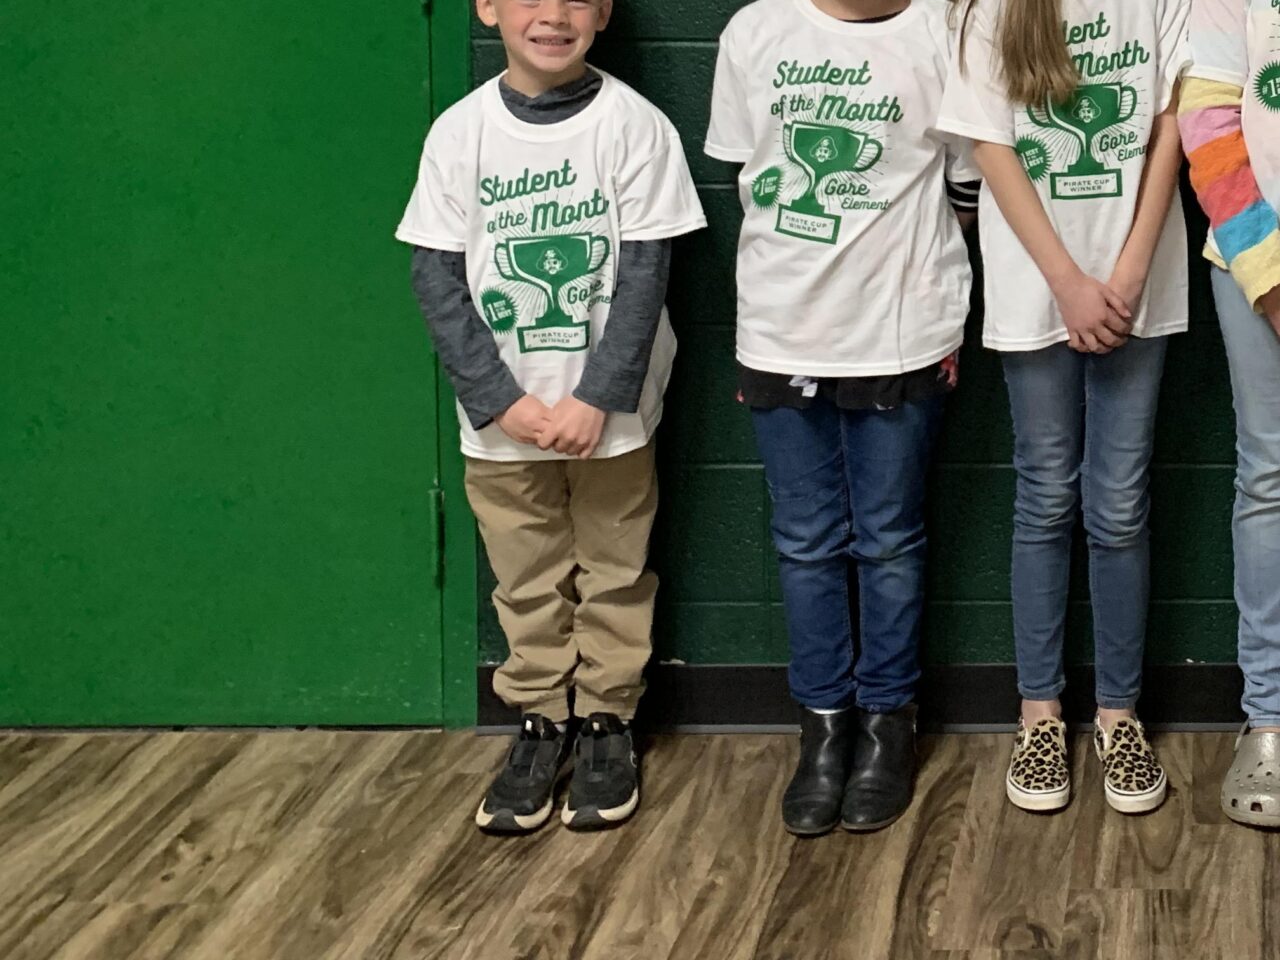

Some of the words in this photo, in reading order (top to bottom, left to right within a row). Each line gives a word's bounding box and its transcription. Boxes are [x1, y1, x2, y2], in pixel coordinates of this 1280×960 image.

[1072, 40, 1150, 78] Month
[773, 59, 872, 88] Student
[771, 95, 787, 119] of
[790, 94, 814, 113] the
[815, 94, 904, 123] Month
[1099, 131, 1138, 152] Gore
[480, 159, 577, 206] Student
[824, 178, 870, 196] Gore
[1070, 185, 1102, 193] WINNER
[498, 210, 527, 229] the
[788, 222, 818, 233] WINNER
[810, 220, 828, 229] CUP
